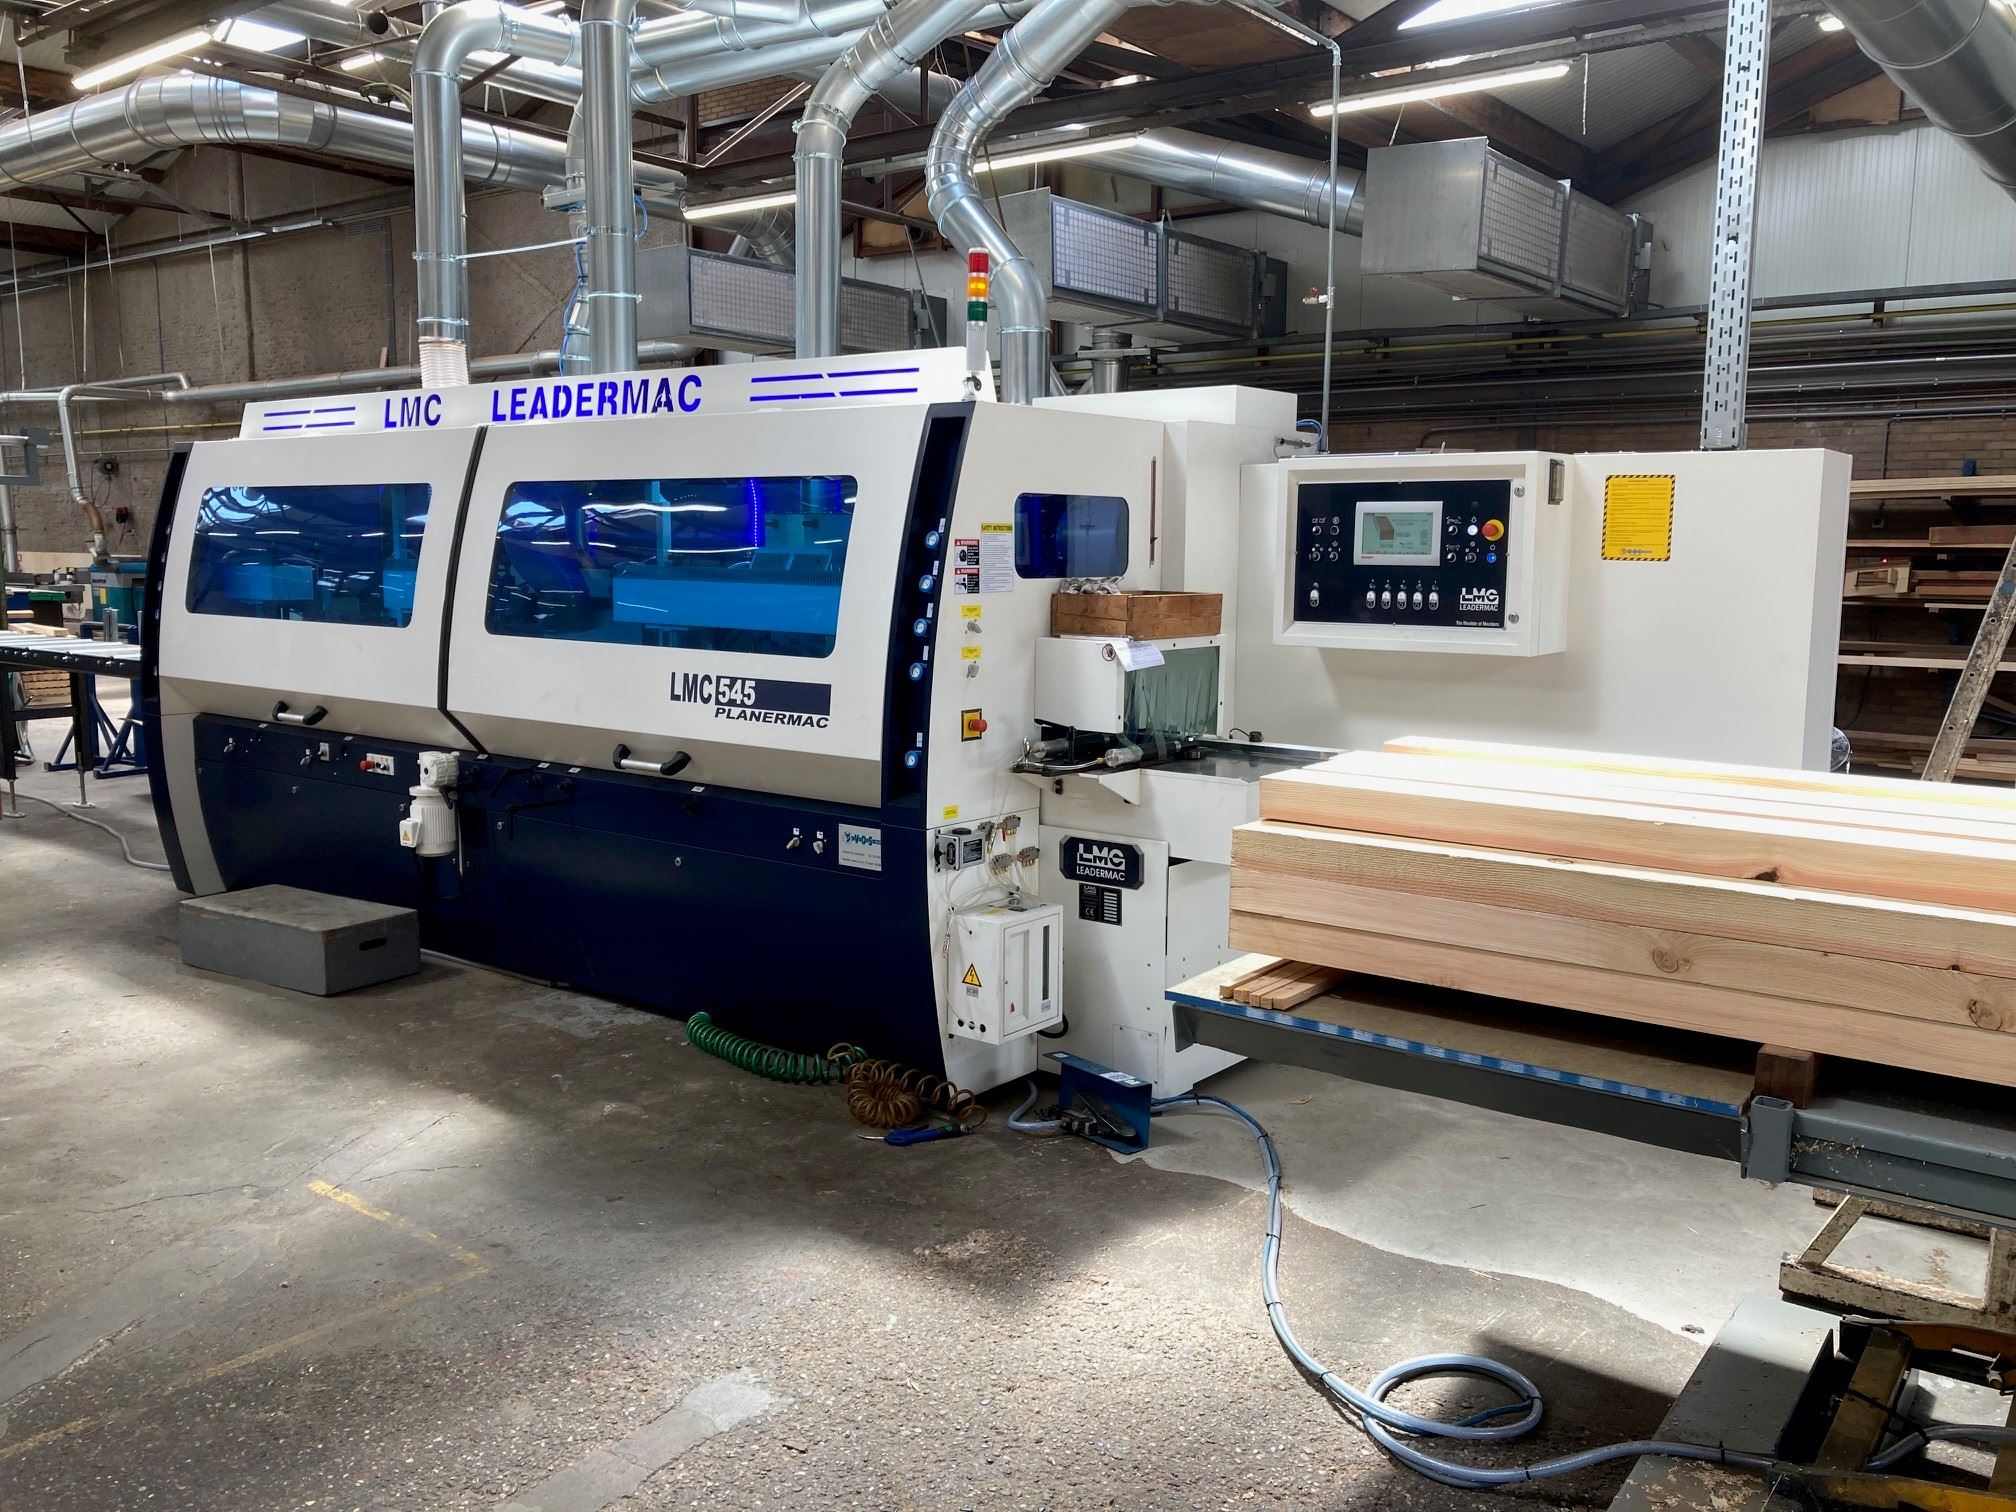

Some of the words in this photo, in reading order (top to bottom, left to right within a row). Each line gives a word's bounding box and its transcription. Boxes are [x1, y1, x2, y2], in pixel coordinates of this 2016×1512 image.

[384, 393, 442, 429] LMC
[492, 374, 703, 422] LEADERMAC
[1460, 588, 1499, 604] LMC
[670, 671, 713, 705] LMC
[718, 678, 756, 706] 545
[714, 707, 830, 729] PLANERMAC
[1076, 843, 1126, 870] LMC
[1076, 865, 1126, 881] LEADERMAC
